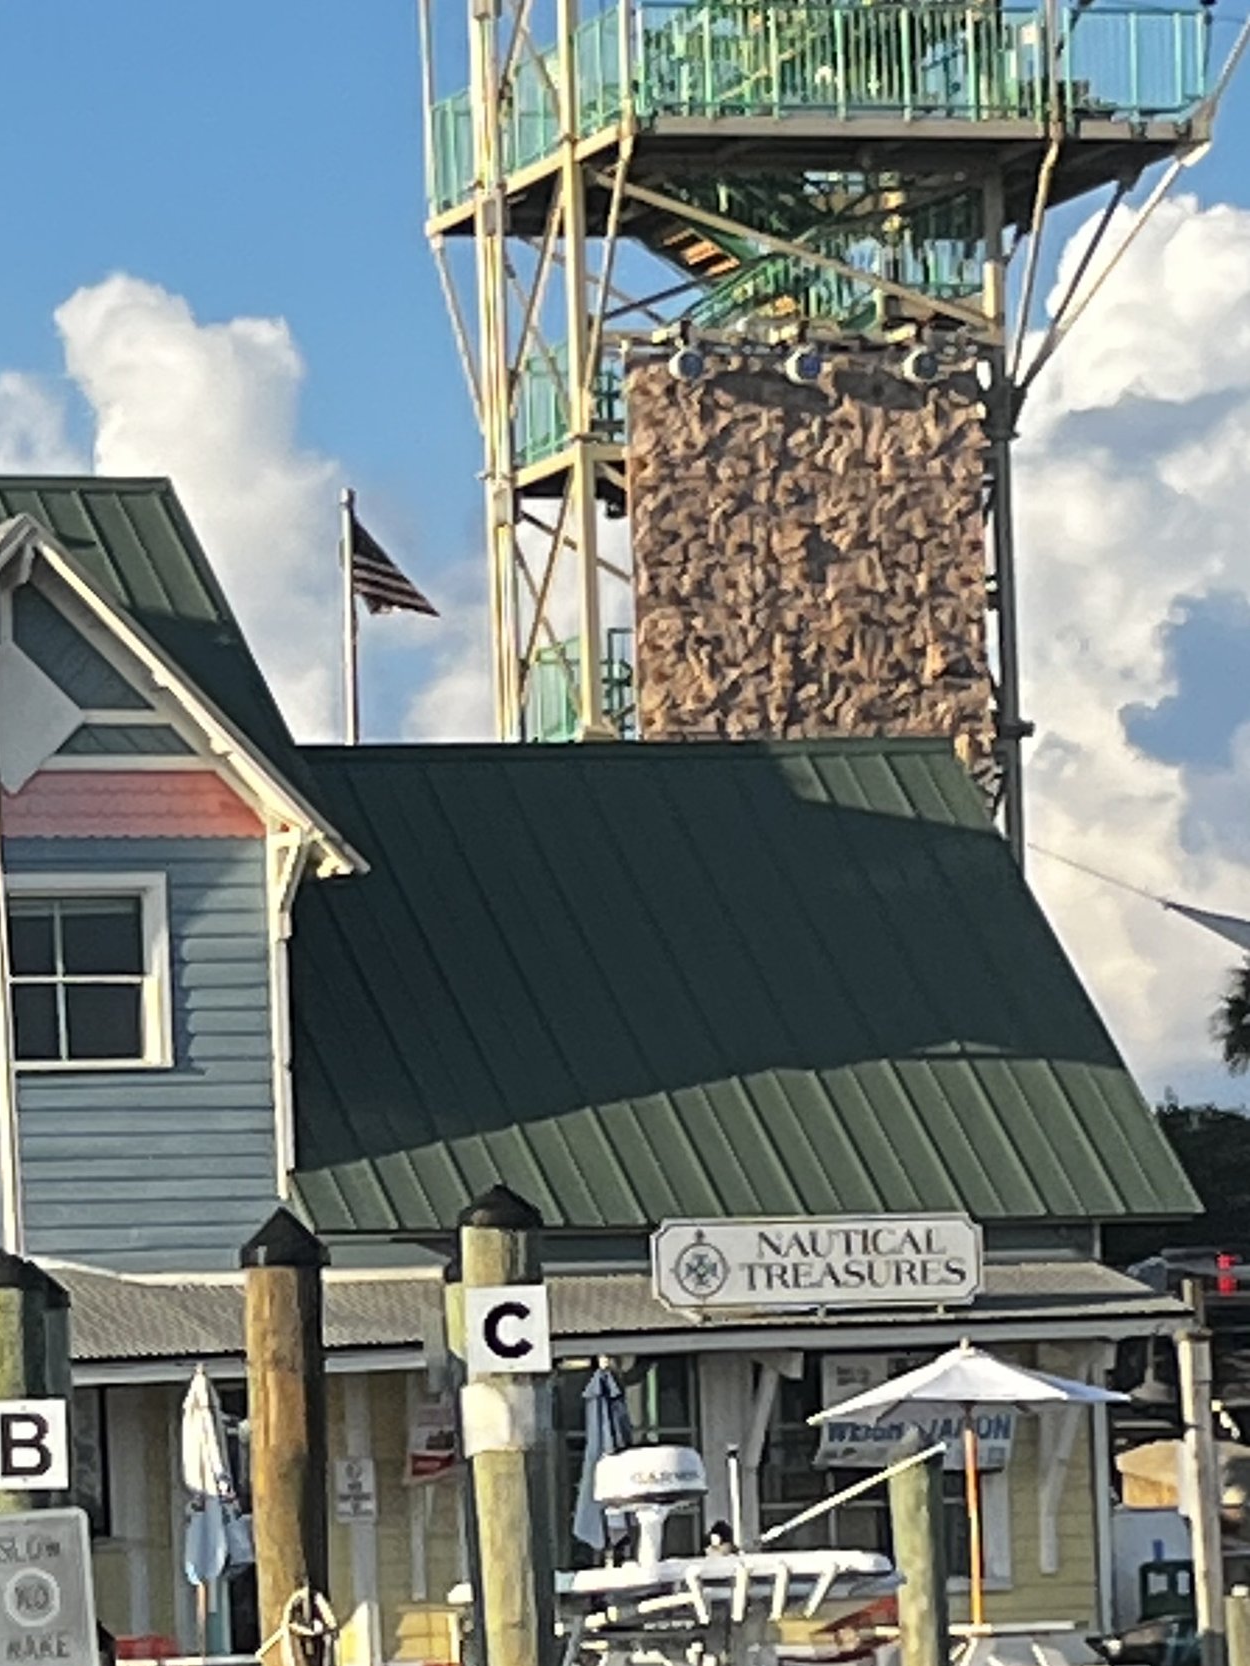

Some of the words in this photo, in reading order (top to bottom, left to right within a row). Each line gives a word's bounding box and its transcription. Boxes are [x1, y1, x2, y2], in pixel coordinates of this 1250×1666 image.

[756, 1228, 948, 1258] NAUTICAL
[740, 1256, 967, 1292] TREASURES
[483, 1300, 534, 1360] C
[0, 1412, 53, 1477] B
[14, 1583, 51, 1612] NO
[5, 1632, 71, 1662] WAKE
